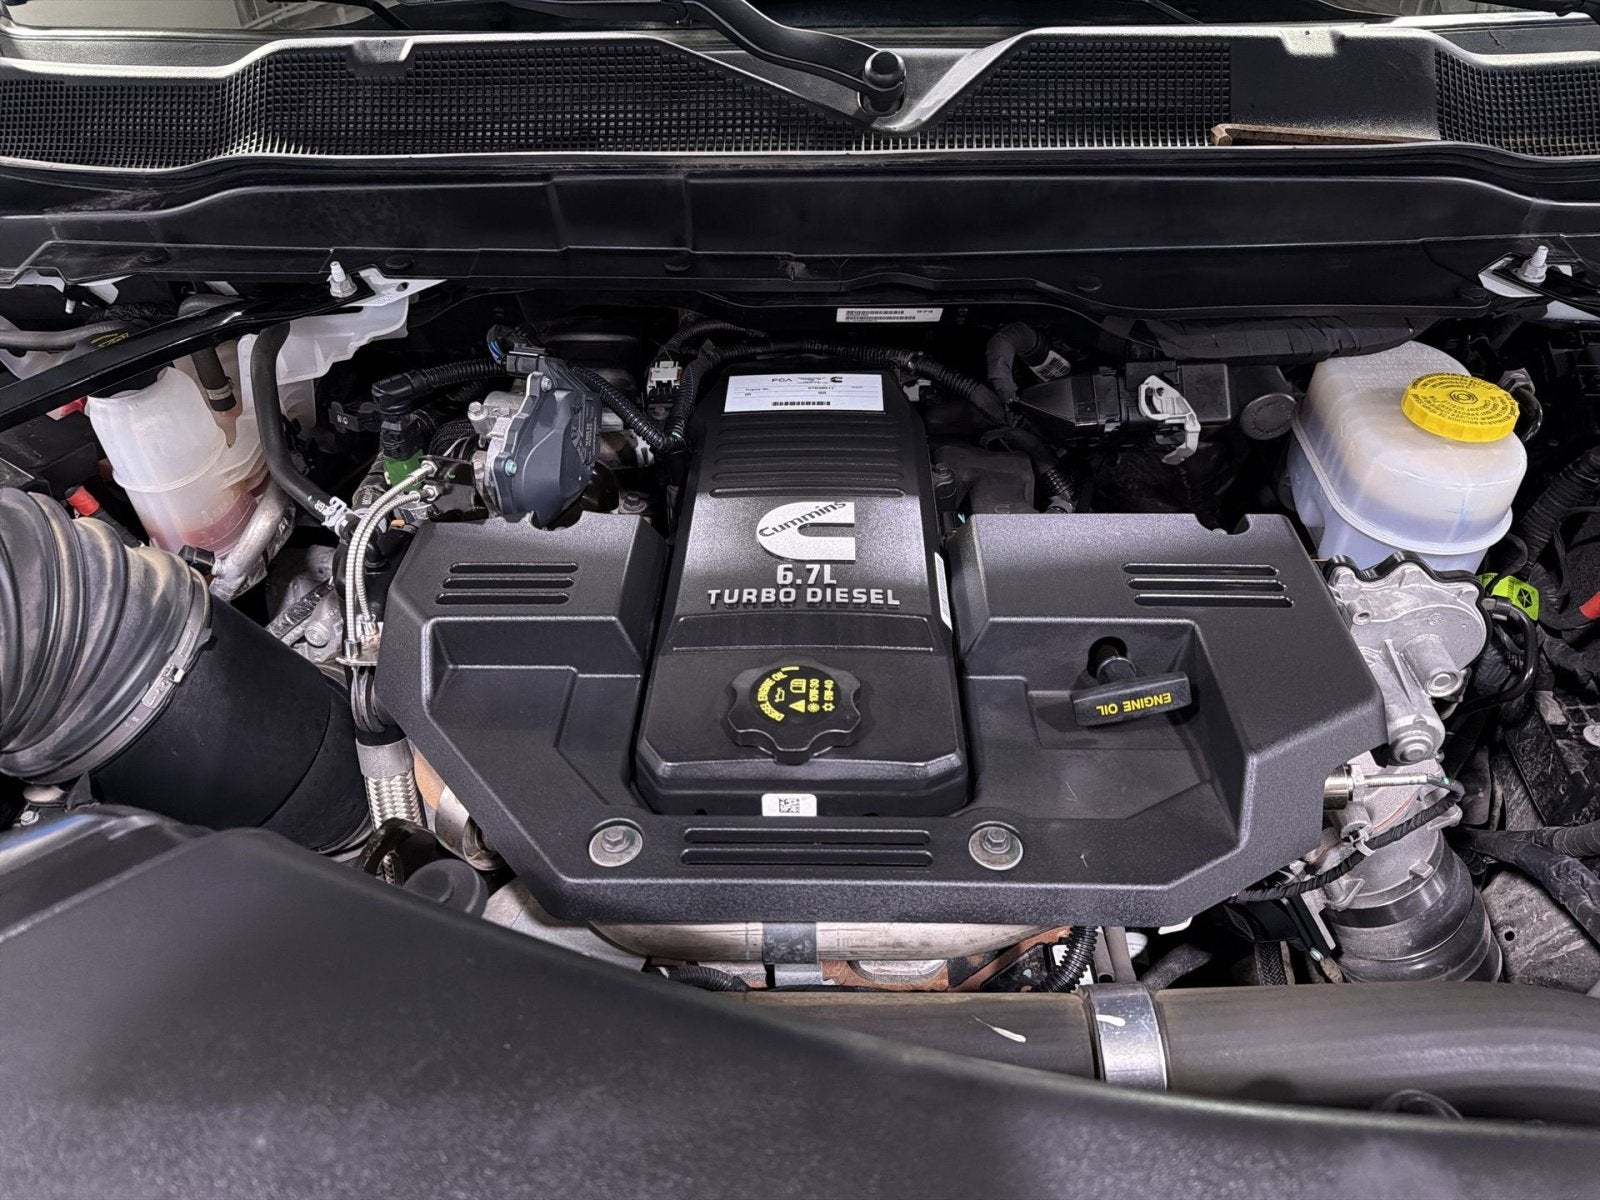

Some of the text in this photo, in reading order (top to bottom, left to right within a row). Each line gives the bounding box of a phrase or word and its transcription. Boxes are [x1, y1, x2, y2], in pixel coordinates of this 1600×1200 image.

[758, 501, 847, 537] Cummins
[777, 564, 836, 586] 6.7L
[707, 587, 900, 606] TURBO DIESEL
[758, 671, 788, 721] DIESEL ENGINE OIL
[809, 678, 820, 702] 10W-30
[823, 679, 834, 701] 5W-40
[1096, 692, 1172, 716] ENGINE OIL
